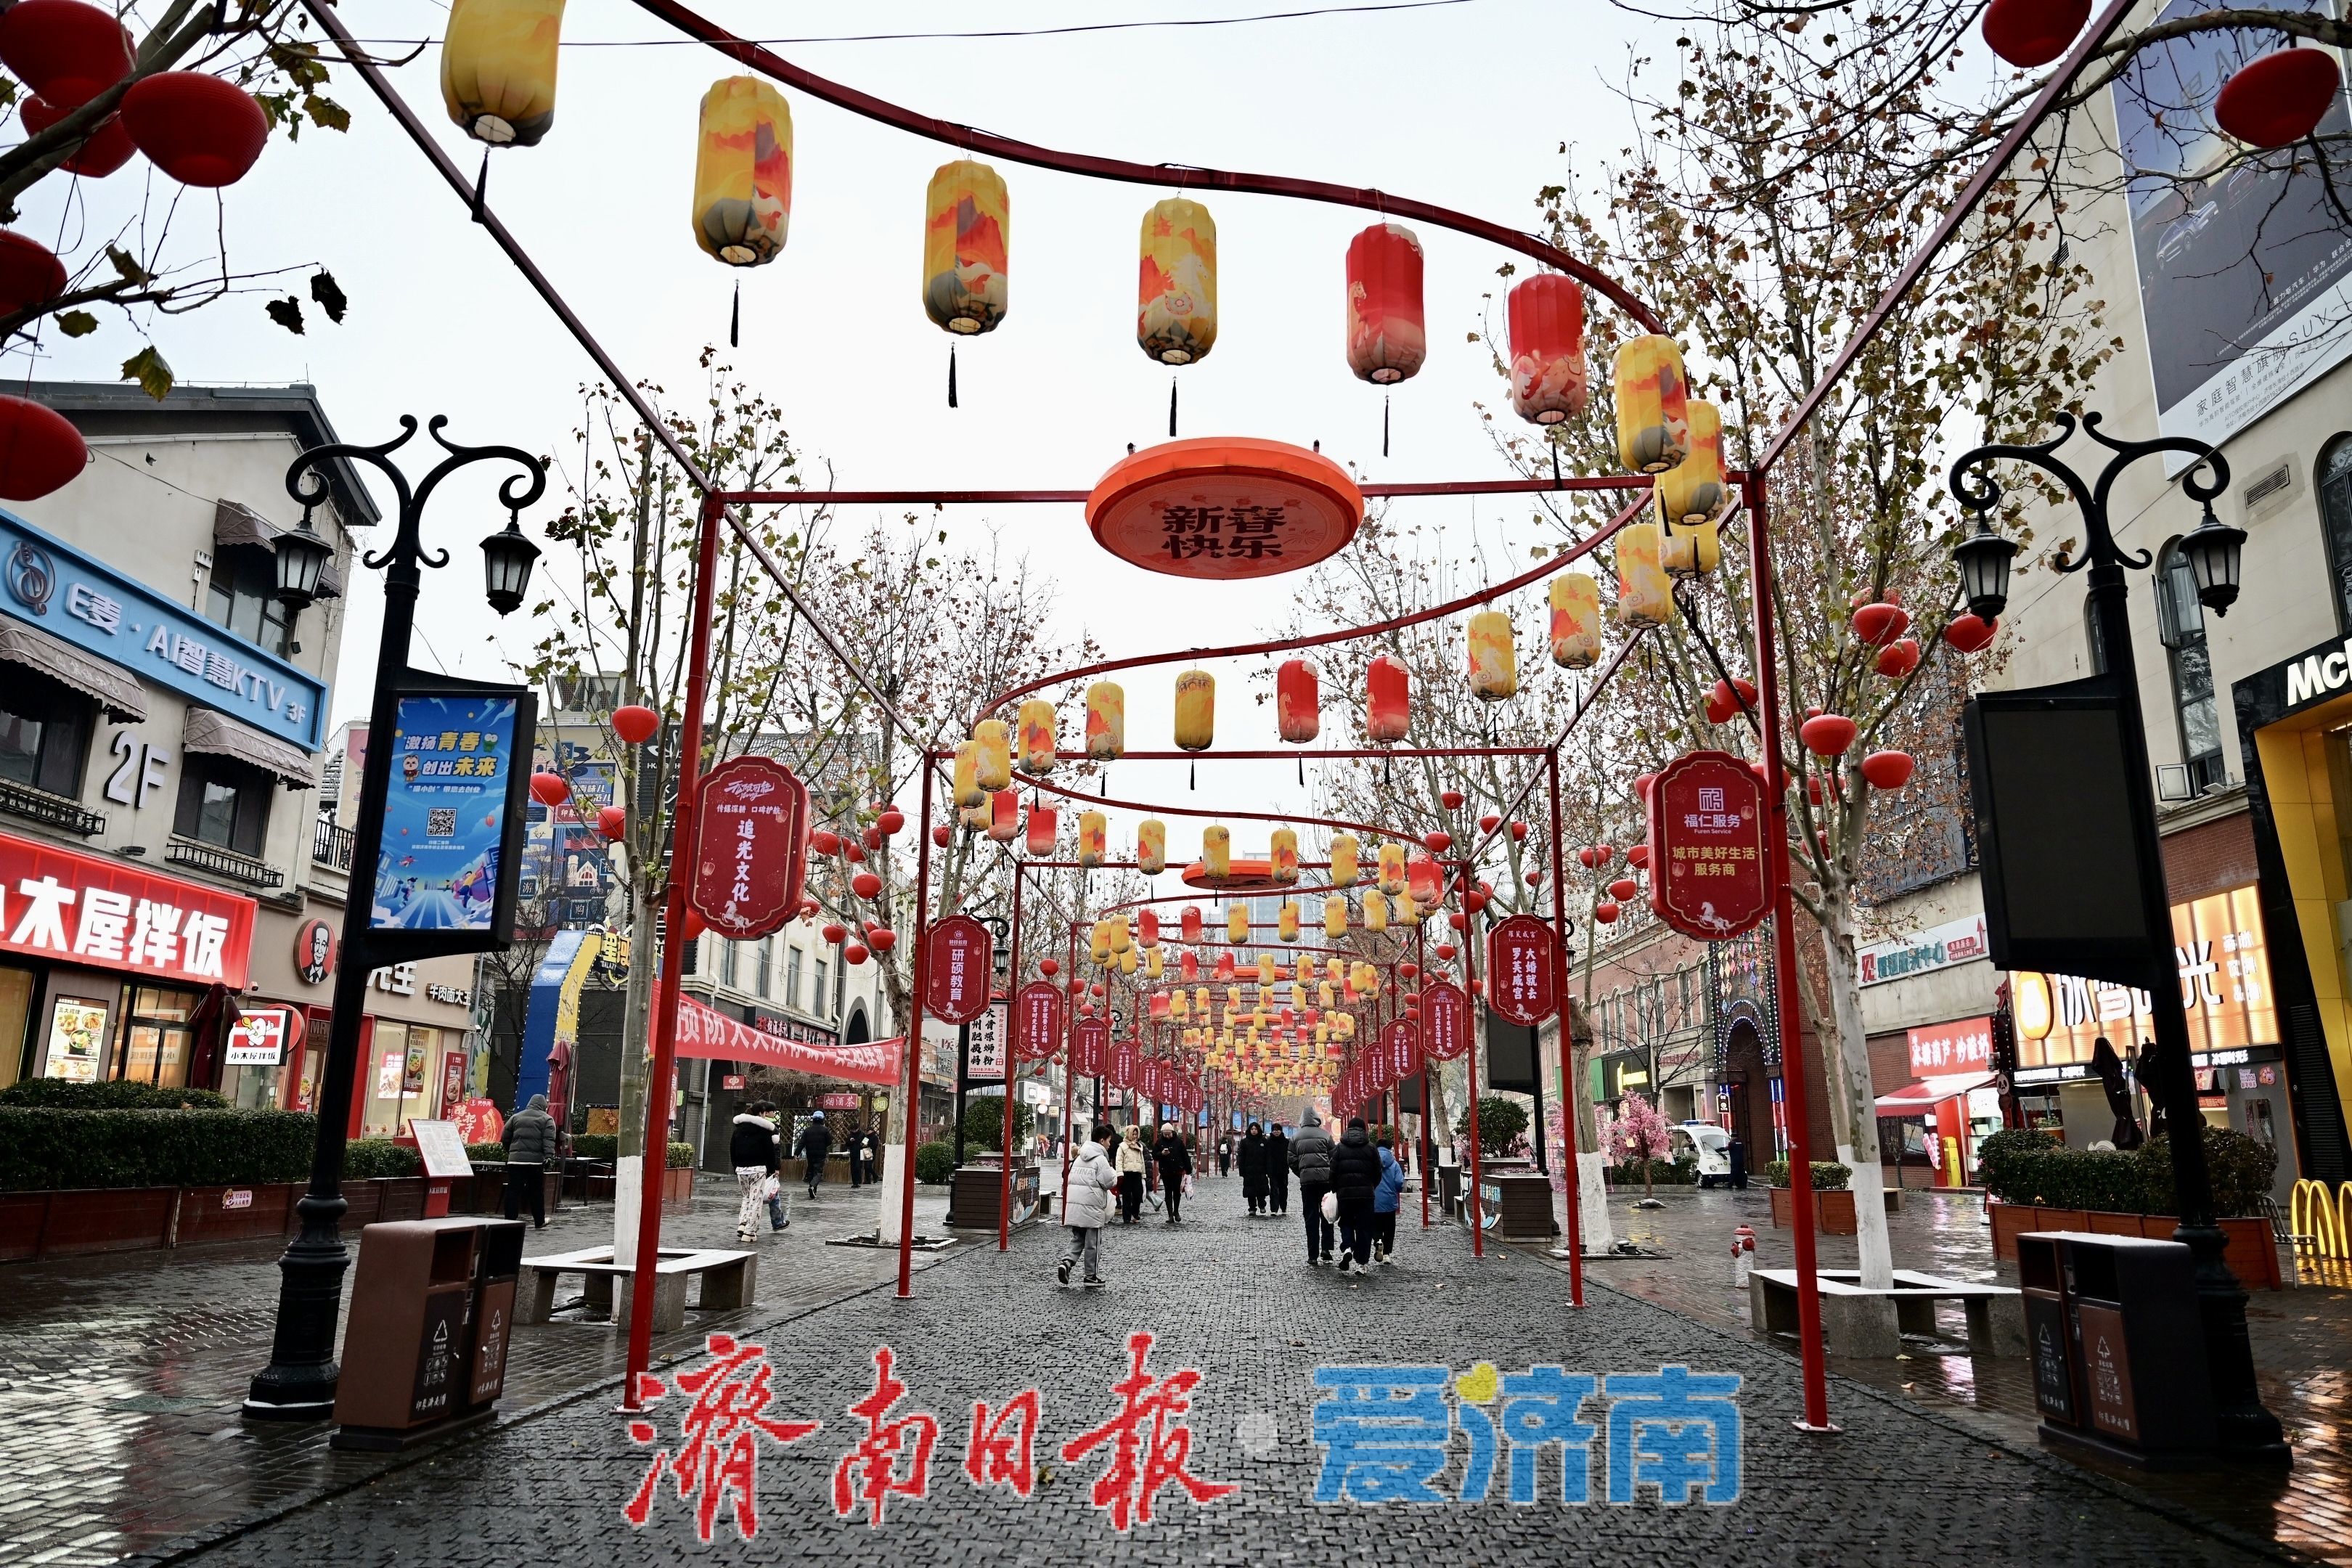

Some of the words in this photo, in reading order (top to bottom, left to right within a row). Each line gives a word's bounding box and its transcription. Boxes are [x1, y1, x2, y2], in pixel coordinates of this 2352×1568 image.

[1161, 535, 1283, 560] 快乐
[2287, 637, 2352, 707] Mc
[286, 701, 306, 724] 3F
[103, 730, 171, 809] 2F
[421, 756, 499, 777] 创出未来
[1684, 814, 1741, 828] 福仁服务
[731, 819, 756, 902] 追光文化
[1672, 846, 1756, 860] 城市美好生活
[1694, 862, 1736, 876] 服务商
[0, 875, 228, 978] 木屋拌饭
[950, 949, 965, 1001] 研硕教育
[1525, 947, 1538, 1000] 大婚就去
[428, 982, 471, 1007] 牛肉面大王
[983, 1008, 996, 1066] 大骨螺蛳粉
[825, 1095, 856, 1107] 烟酒茶
